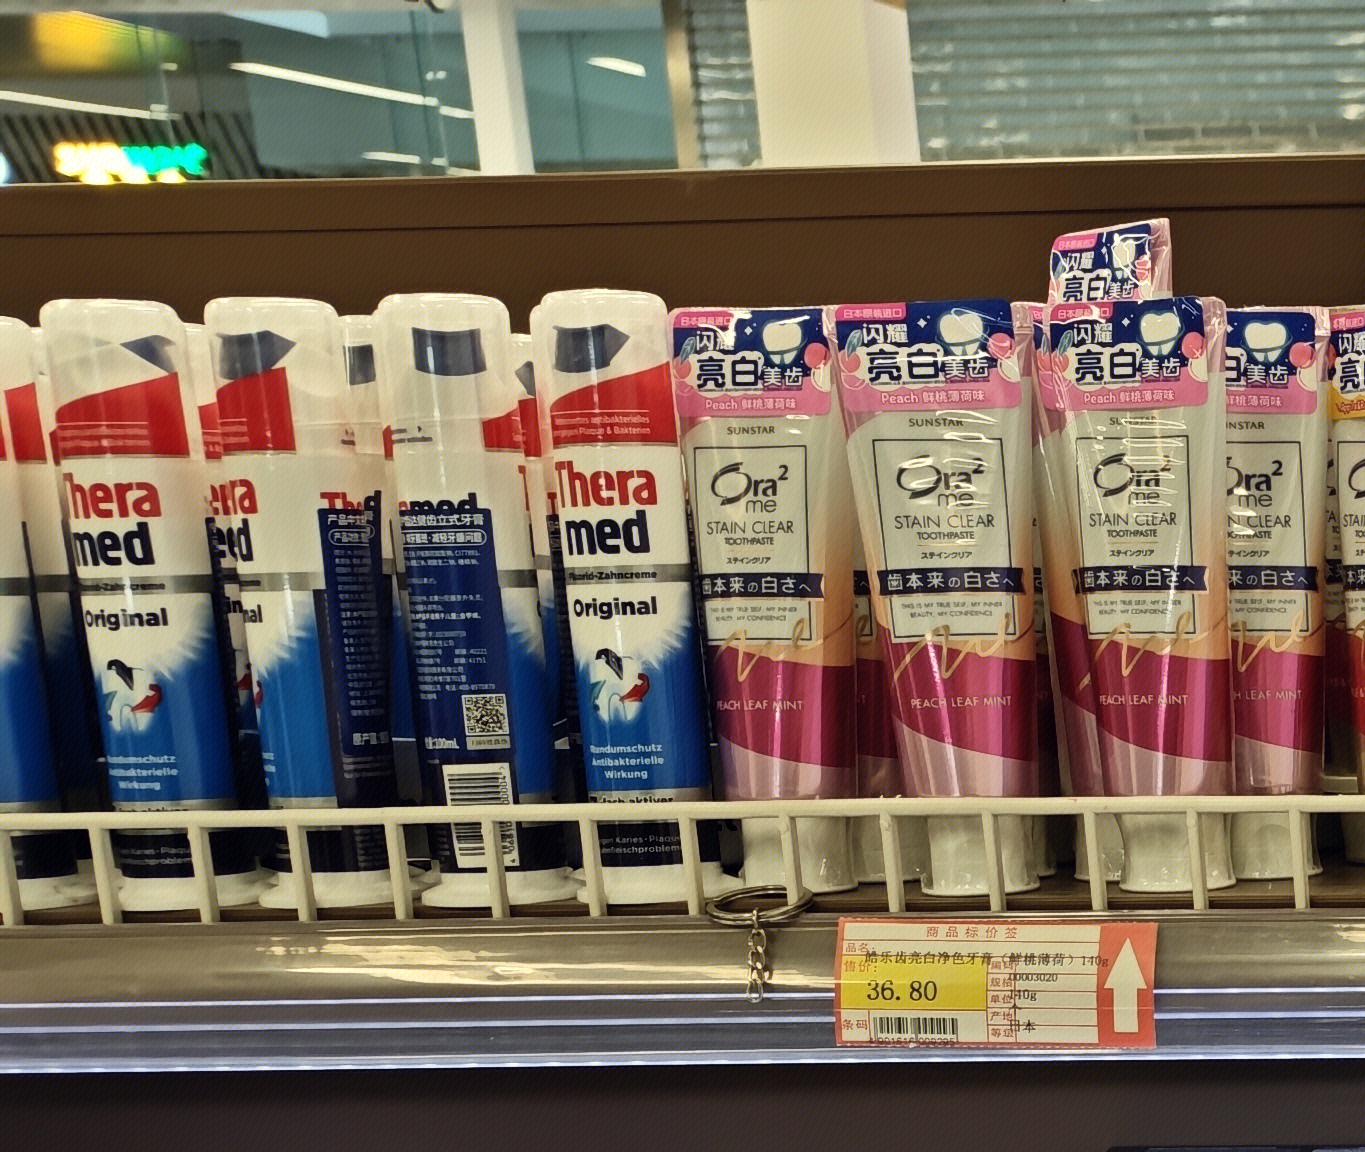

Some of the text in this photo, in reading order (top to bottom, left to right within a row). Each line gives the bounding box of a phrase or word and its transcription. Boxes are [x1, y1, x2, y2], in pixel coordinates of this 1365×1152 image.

[864, 324, 908, 344] 闪耀
[867, 347, 940, 381] 亮白
[881, 390, 985, 405] Peach 鲜桃薄荷味
[908, 417, 963, 428] SUNSTAR
[894, 513, 995, 528] STAIN CLEAR
[566, 510, 651, 555] med
[917, 531, 975, 540] TOOTHPASTE
[920, 551, 973, 560] ステインクリア
[888, 570, 1015, 591] 歯本来の白さへ
[573, 596, 658, 619] Original
[910, 696, 1012, 708] PEACH LEAF MINT
[604, 769, 649, 780] Wirkung
[926, 926, 1019, 939] 商品标价签
[866, 980, 937, 1001] 36.80
